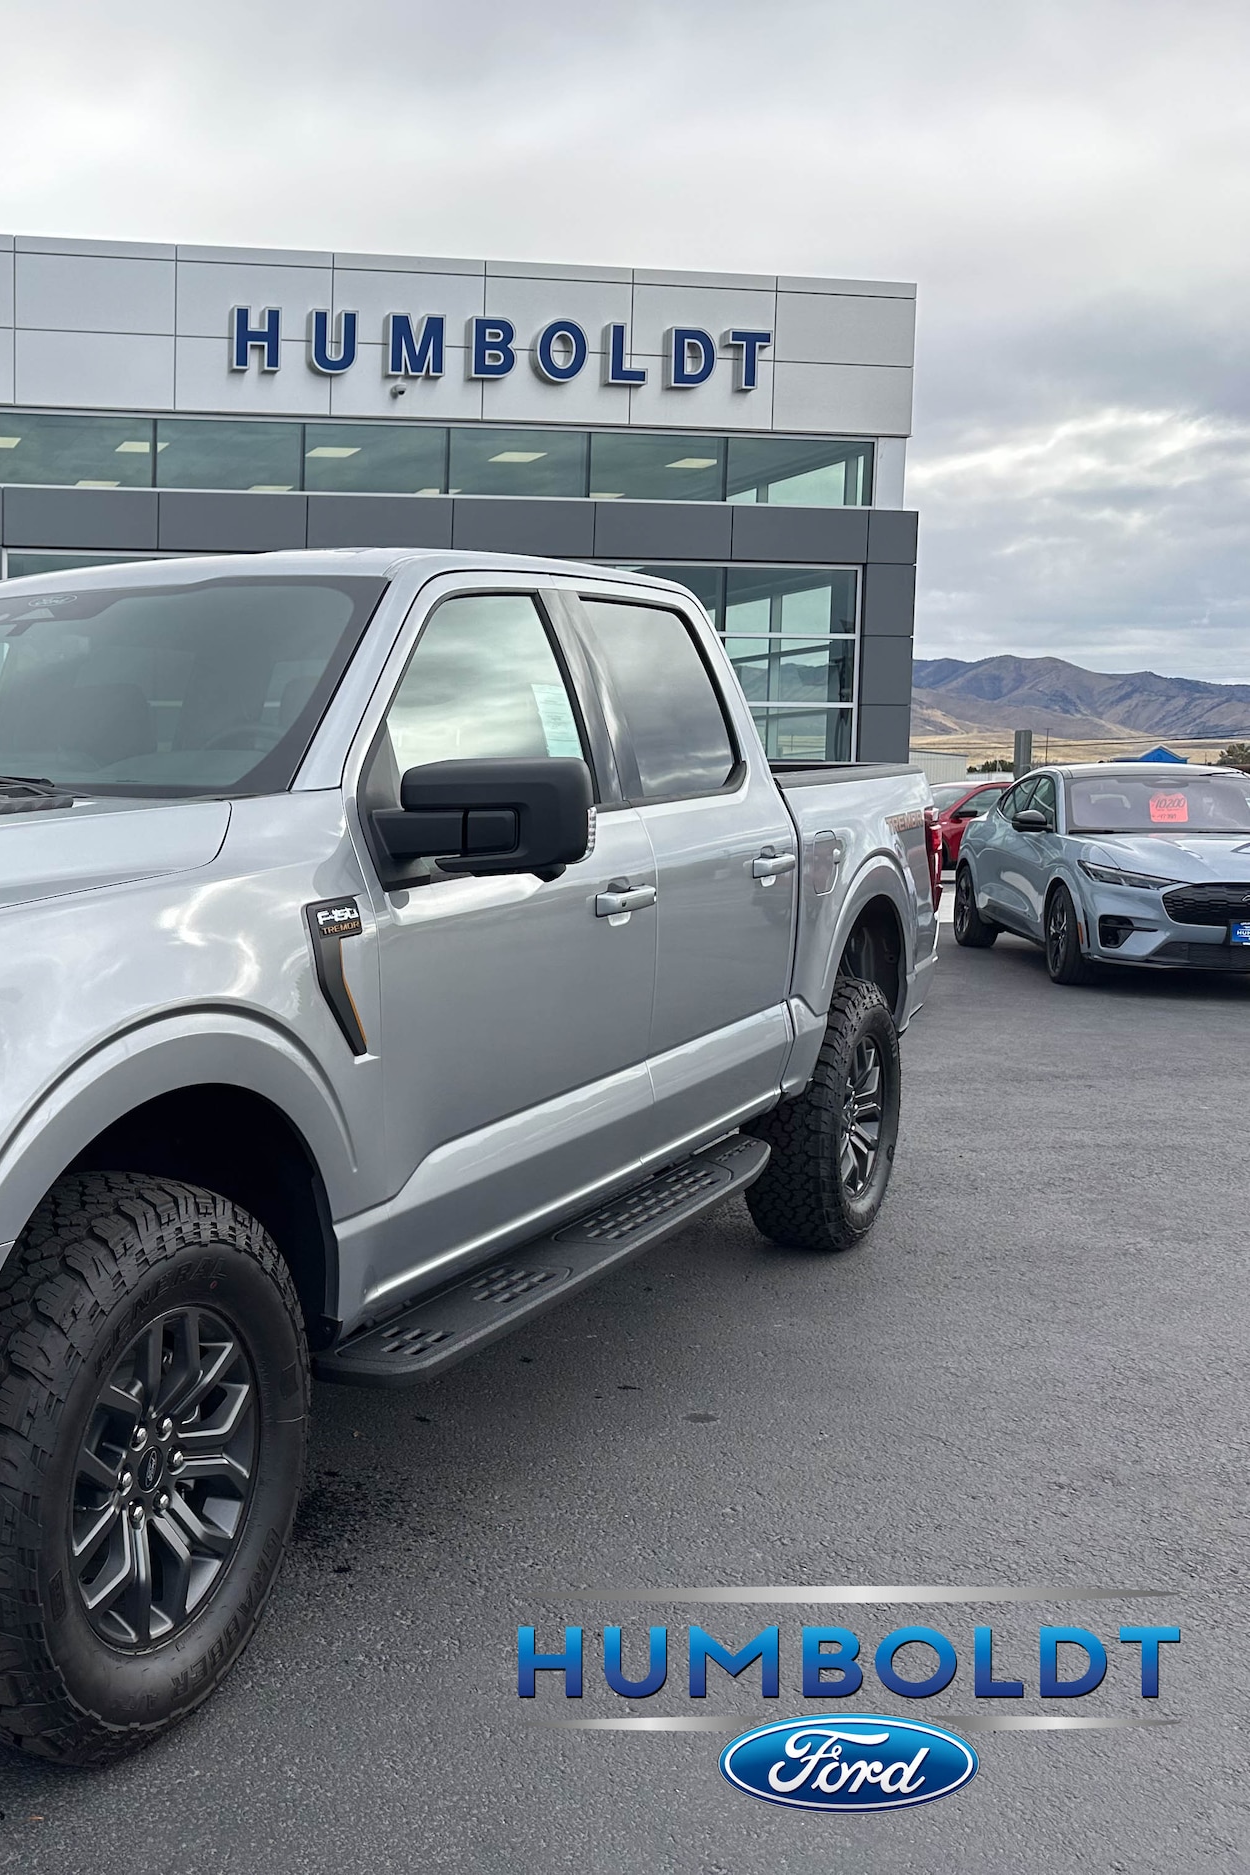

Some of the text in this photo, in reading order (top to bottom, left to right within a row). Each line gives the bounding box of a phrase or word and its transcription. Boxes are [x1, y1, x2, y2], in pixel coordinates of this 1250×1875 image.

[231, 305, 773, 392] HUMBOLDT
[884, 810, 923, 835] TREMOR
[317, 907, 359, 925] F-150
[322, 921, 360, 935] TREMOR
